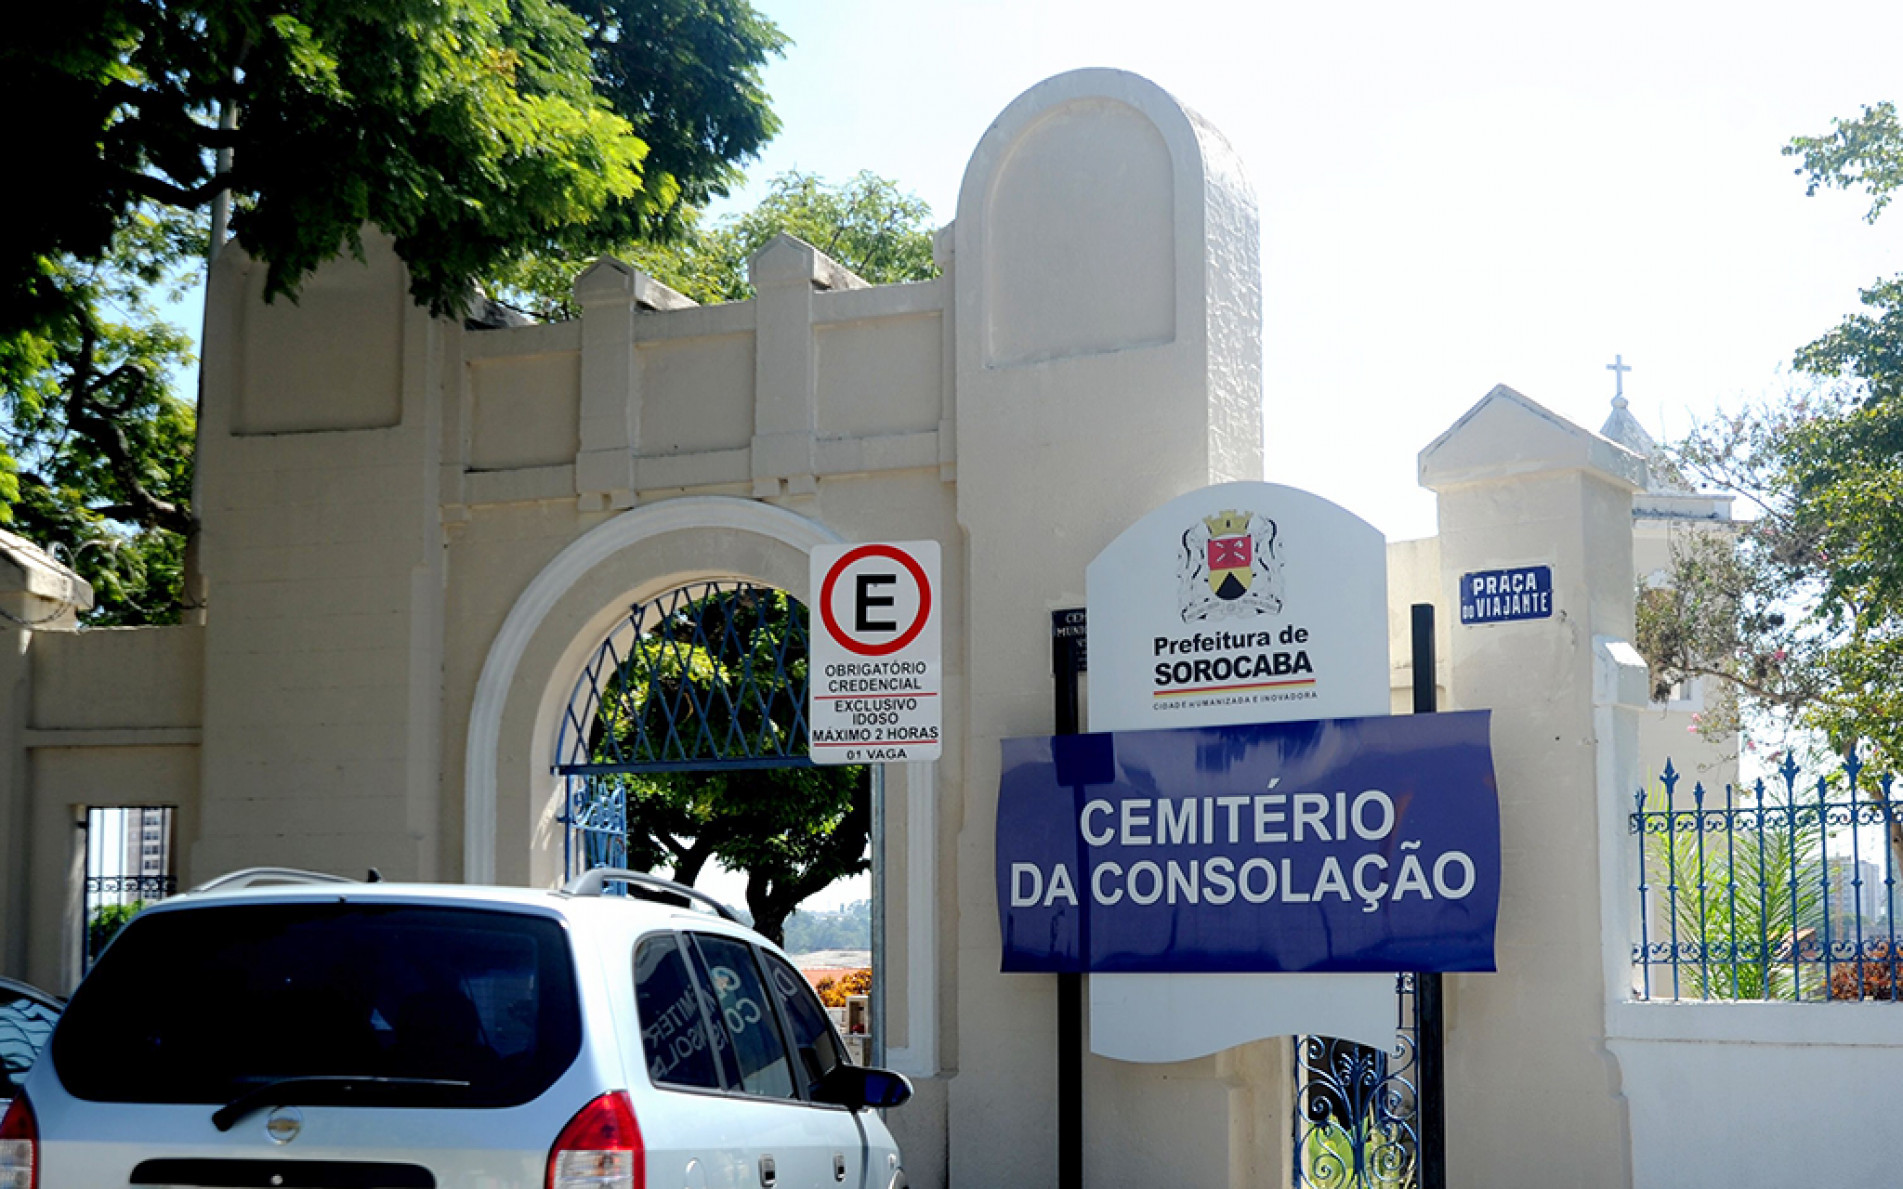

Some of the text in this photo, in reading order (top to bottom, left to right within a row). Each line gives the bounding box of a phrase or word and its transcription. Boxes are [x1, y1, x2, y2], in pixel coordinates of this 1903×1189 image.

[1473, 572, 1538, 596] PRAÇA
[855, 574, 896, 632] E
[1476, 592, 1548, 618] VIAJANTE
[1154, 624, 1309, 656] Prefeitura de
[825, 658, 926, 677] OBRIGATÓRIO
[1154, 650, 1313, 686] SOROCABA
[828, 678, 922, 693] CREDENCIAL
[834, 698, 917, 713] EXCLUSIVO
[1152, 701, 1187, 711] CIDADE
[1189, 696, 1250, 709] HUMANIZADA
[1260, 691, 1318, 703] INOVADORA
[852, 712, 899, 726] IDOSO
[812, 726, 939, 742] MÁXIMO 2 HORAS
[846, 748, 907, 760] 01 VAGA
[1080, 777, 1395, 847] CEMITÉRIO
[1010, 840, 1476, 913] DA CONSOLAÇÃO
